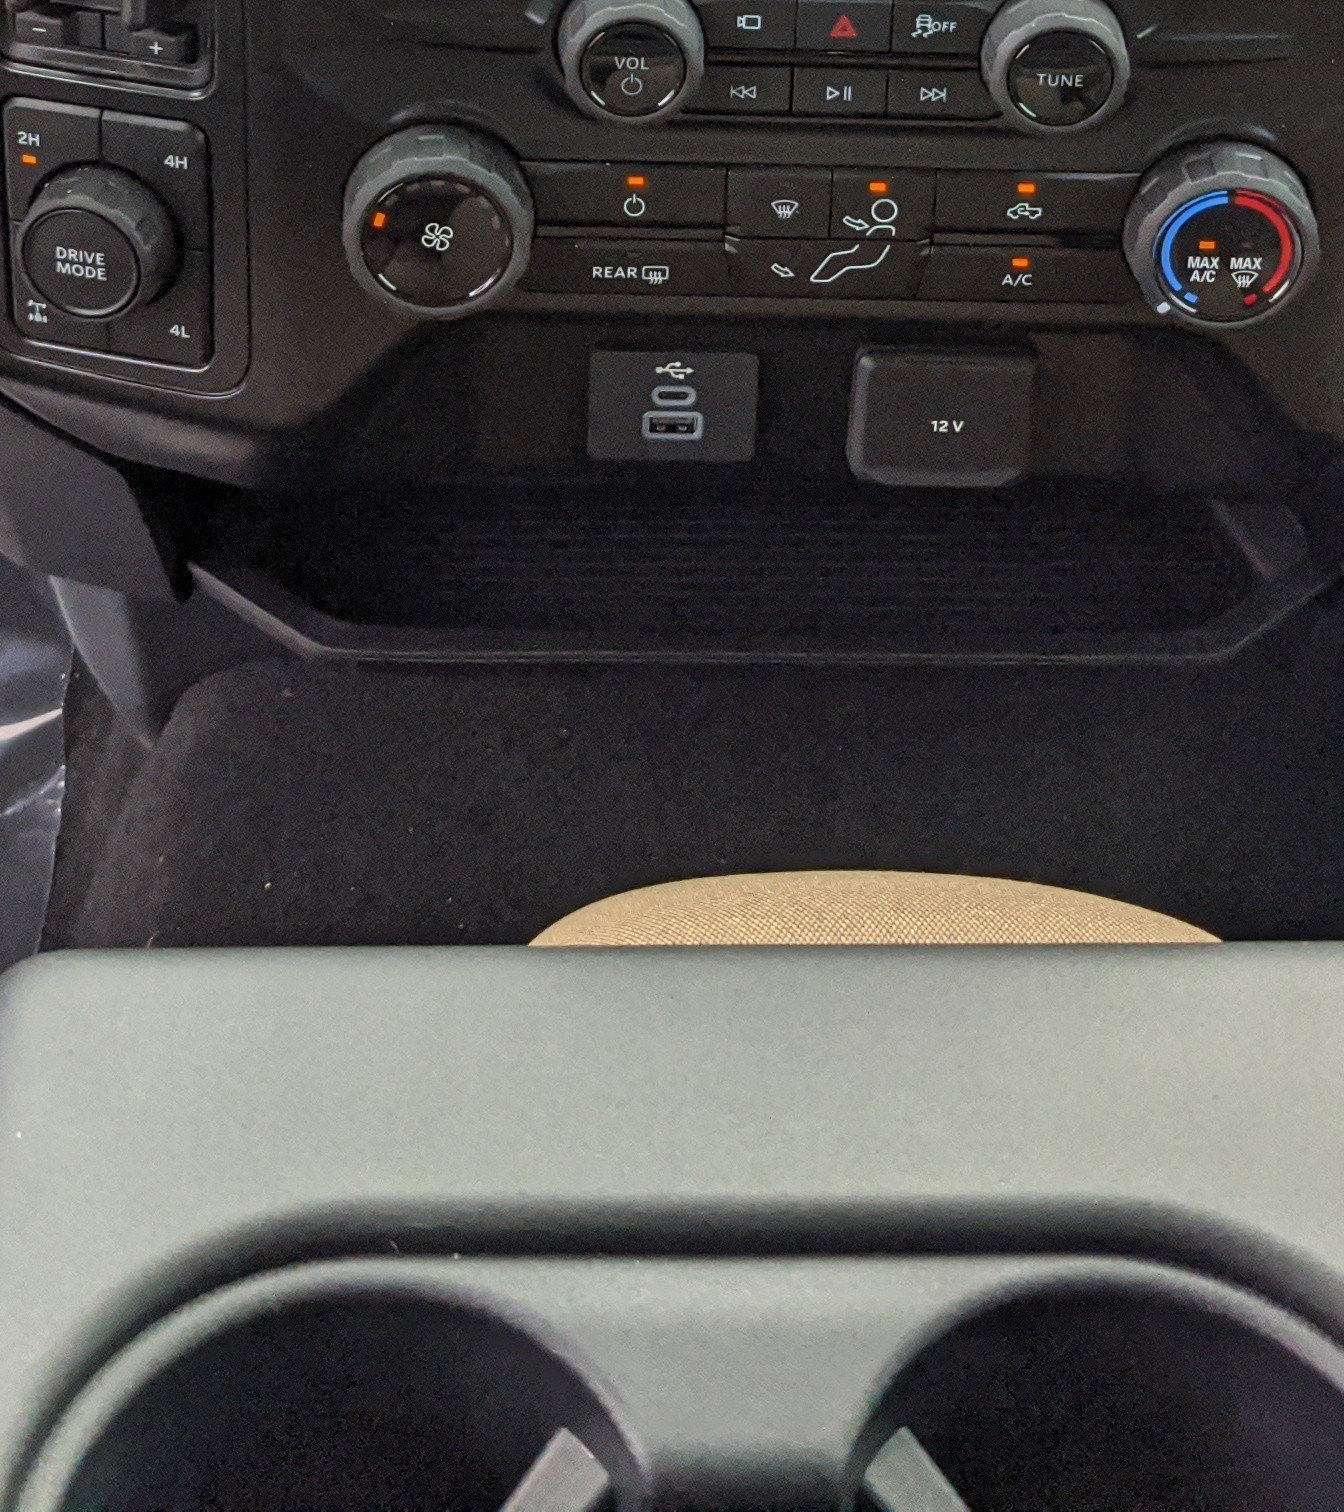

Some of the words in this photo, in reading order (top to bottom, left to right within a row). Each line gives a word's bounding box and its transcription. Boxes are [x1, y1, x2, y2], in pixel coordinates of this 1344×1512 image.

[931, 19, 958, 36] OFF
[613, 55, 650, 71] VOL
[1036, 72, 1085, 90] TUNE
[16, 131, 41, 148] 2H
[163, 153, 189, 171] 4H
[55, 246, 106, 267] DRIVE
[1187, 256, 1220, 270] MAX
[1229, 257, 1263, 270] MAX
[56, 261, 107, 281] MODE
[592, 265, 638, 280] REAR
[1189, 269, 1217, 283] A/C
[1001, 272, 1033, 288] A/C
[169, 322, 190, 339] 4L
[931, 419, 948, 434] 12
[951, 419, 964, 434] V
